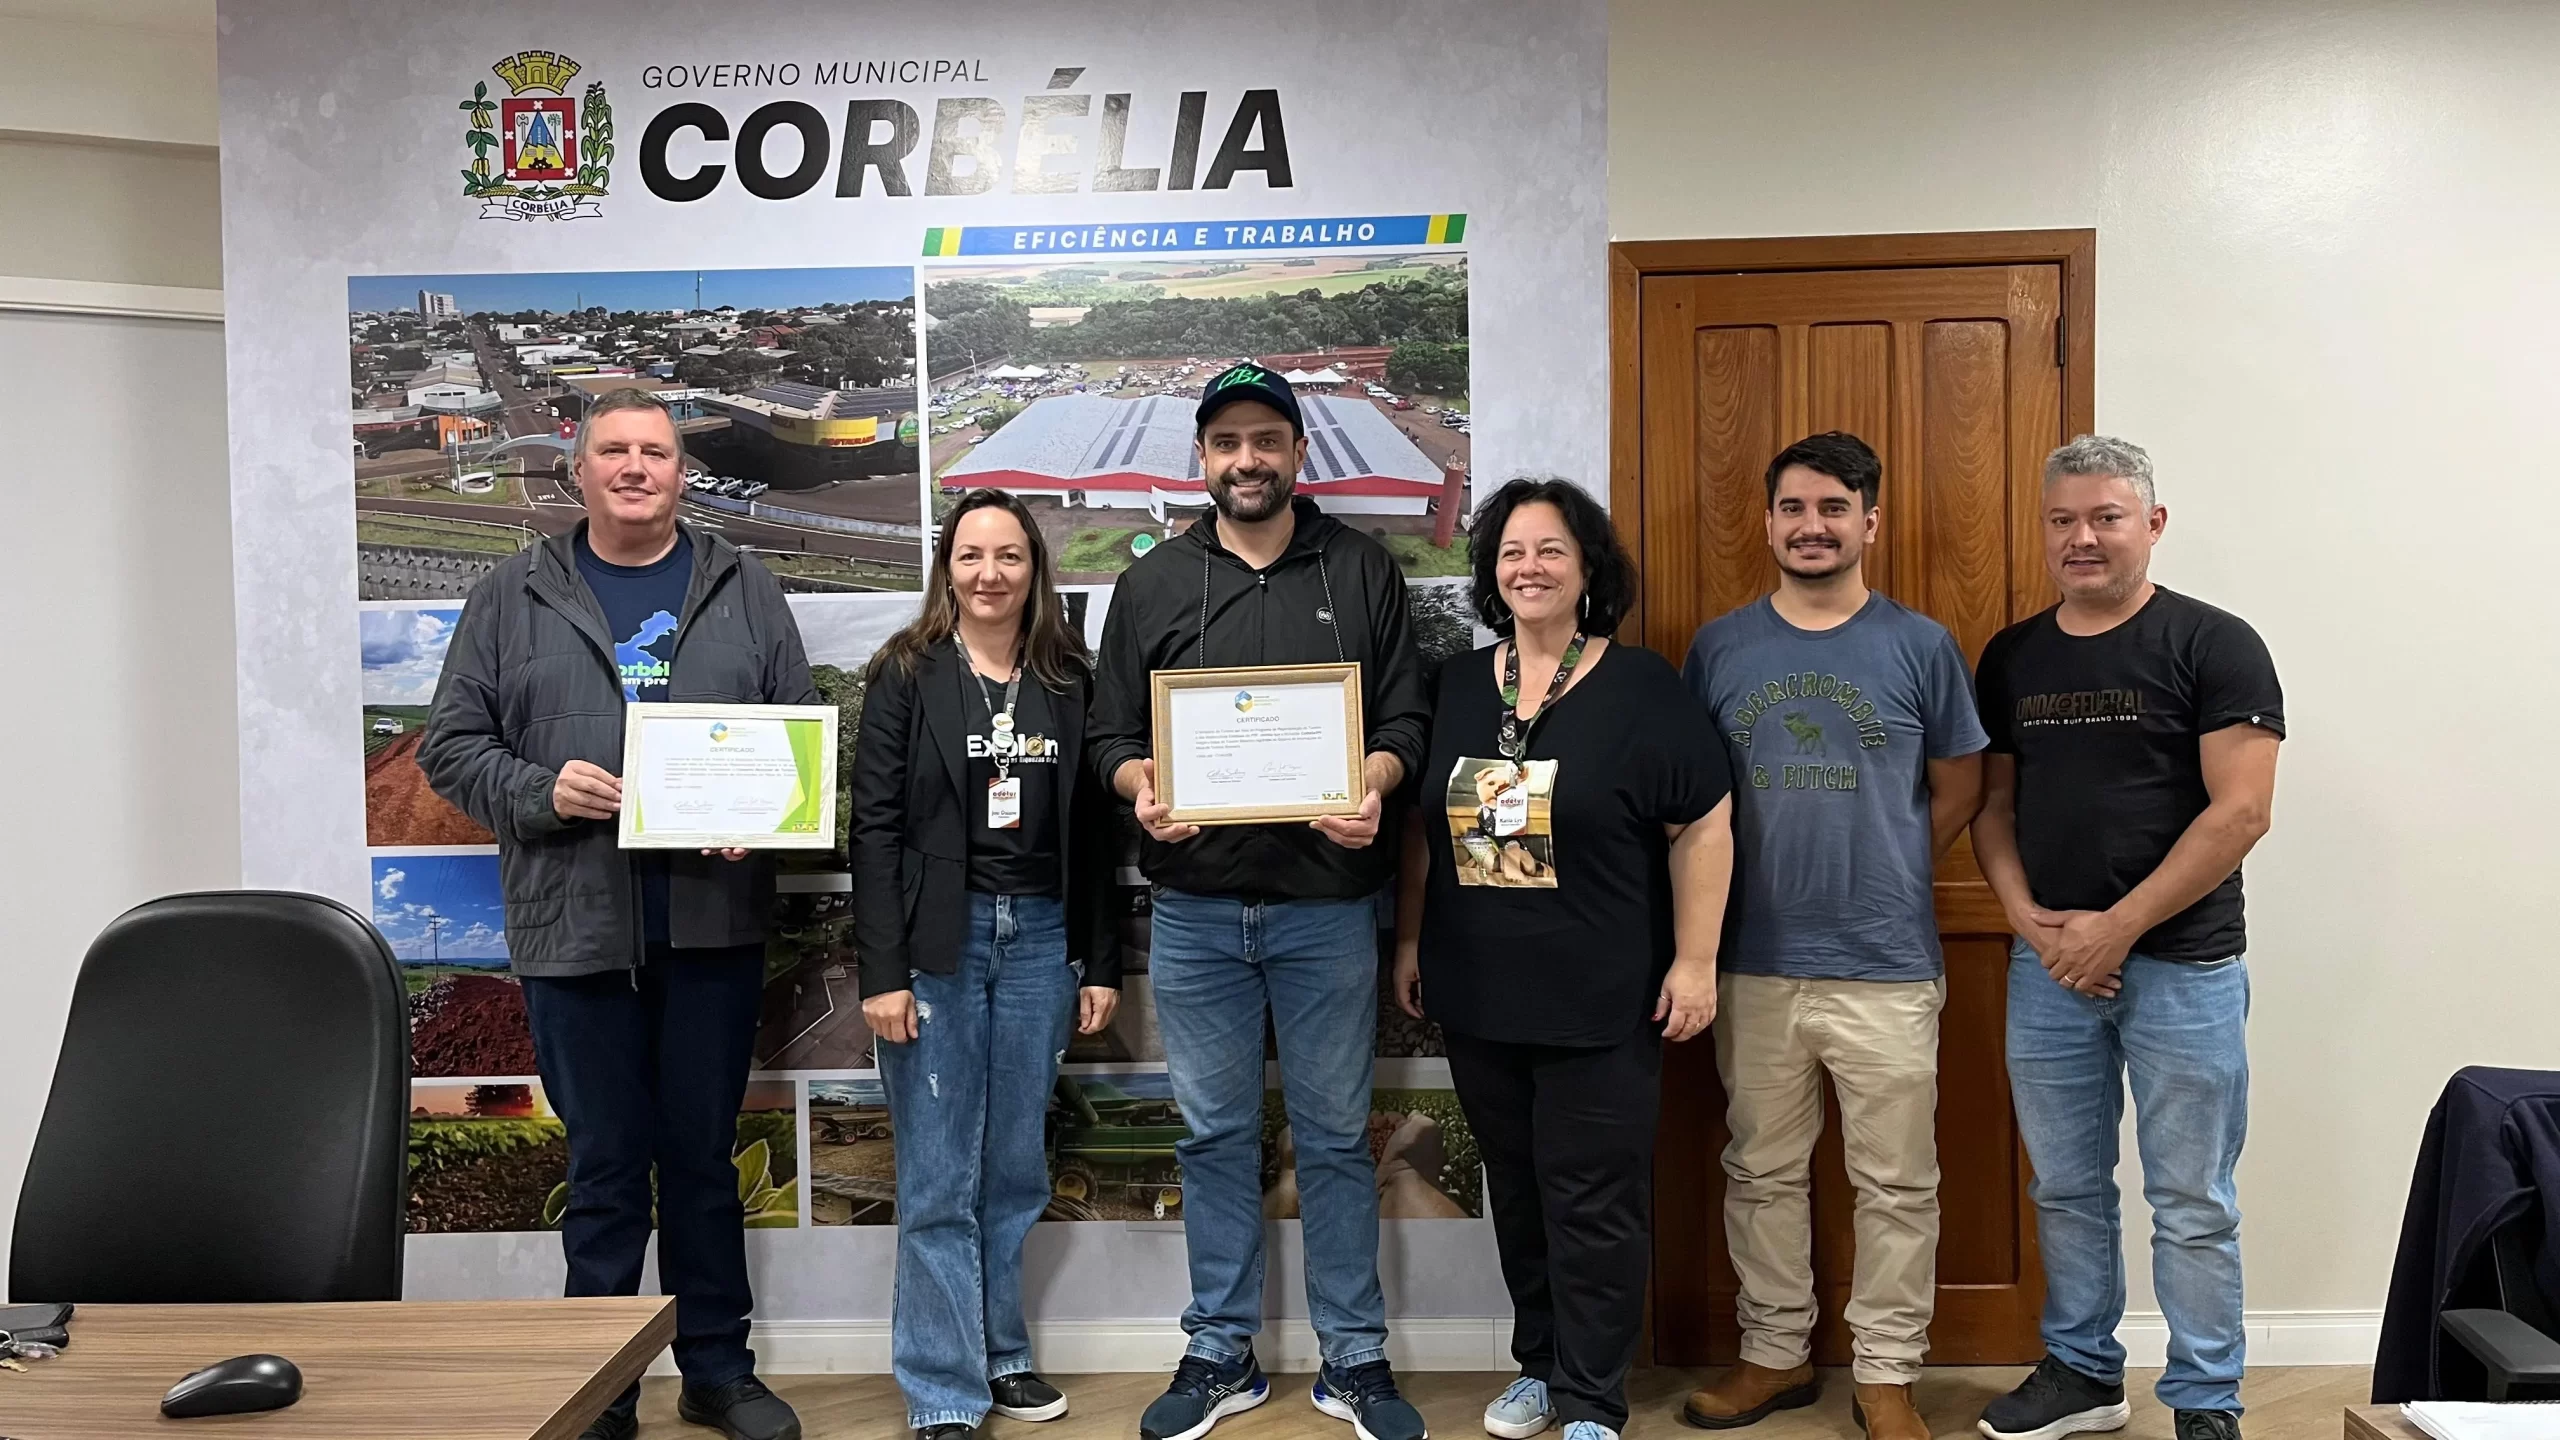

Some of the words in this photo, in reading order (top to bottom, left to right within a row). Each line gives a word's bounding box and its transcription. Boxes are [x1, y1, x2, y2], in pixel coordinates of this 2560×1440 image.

[642, 61, 801, 89] GOVERNO
[814, 59, 989, 86] MUNICIPAL
[639, 67, 1293, 202] CORBÉLIA
[512, 199, 569, 215] CORBÉLIA
[1013, 224, 1178, 250] EFICIÊNCIA
[1194, 226, 1208, 246] E
[1224, 222, 1376, 245] TRABALHO
[1236, 715, 1280, 724] CERTIFICADO
[1729, 671, 1887, 748] ABERCROMBIE
[1752, 765, 1770, 788] &
[1783, 764, 1858, 789] FITCH
